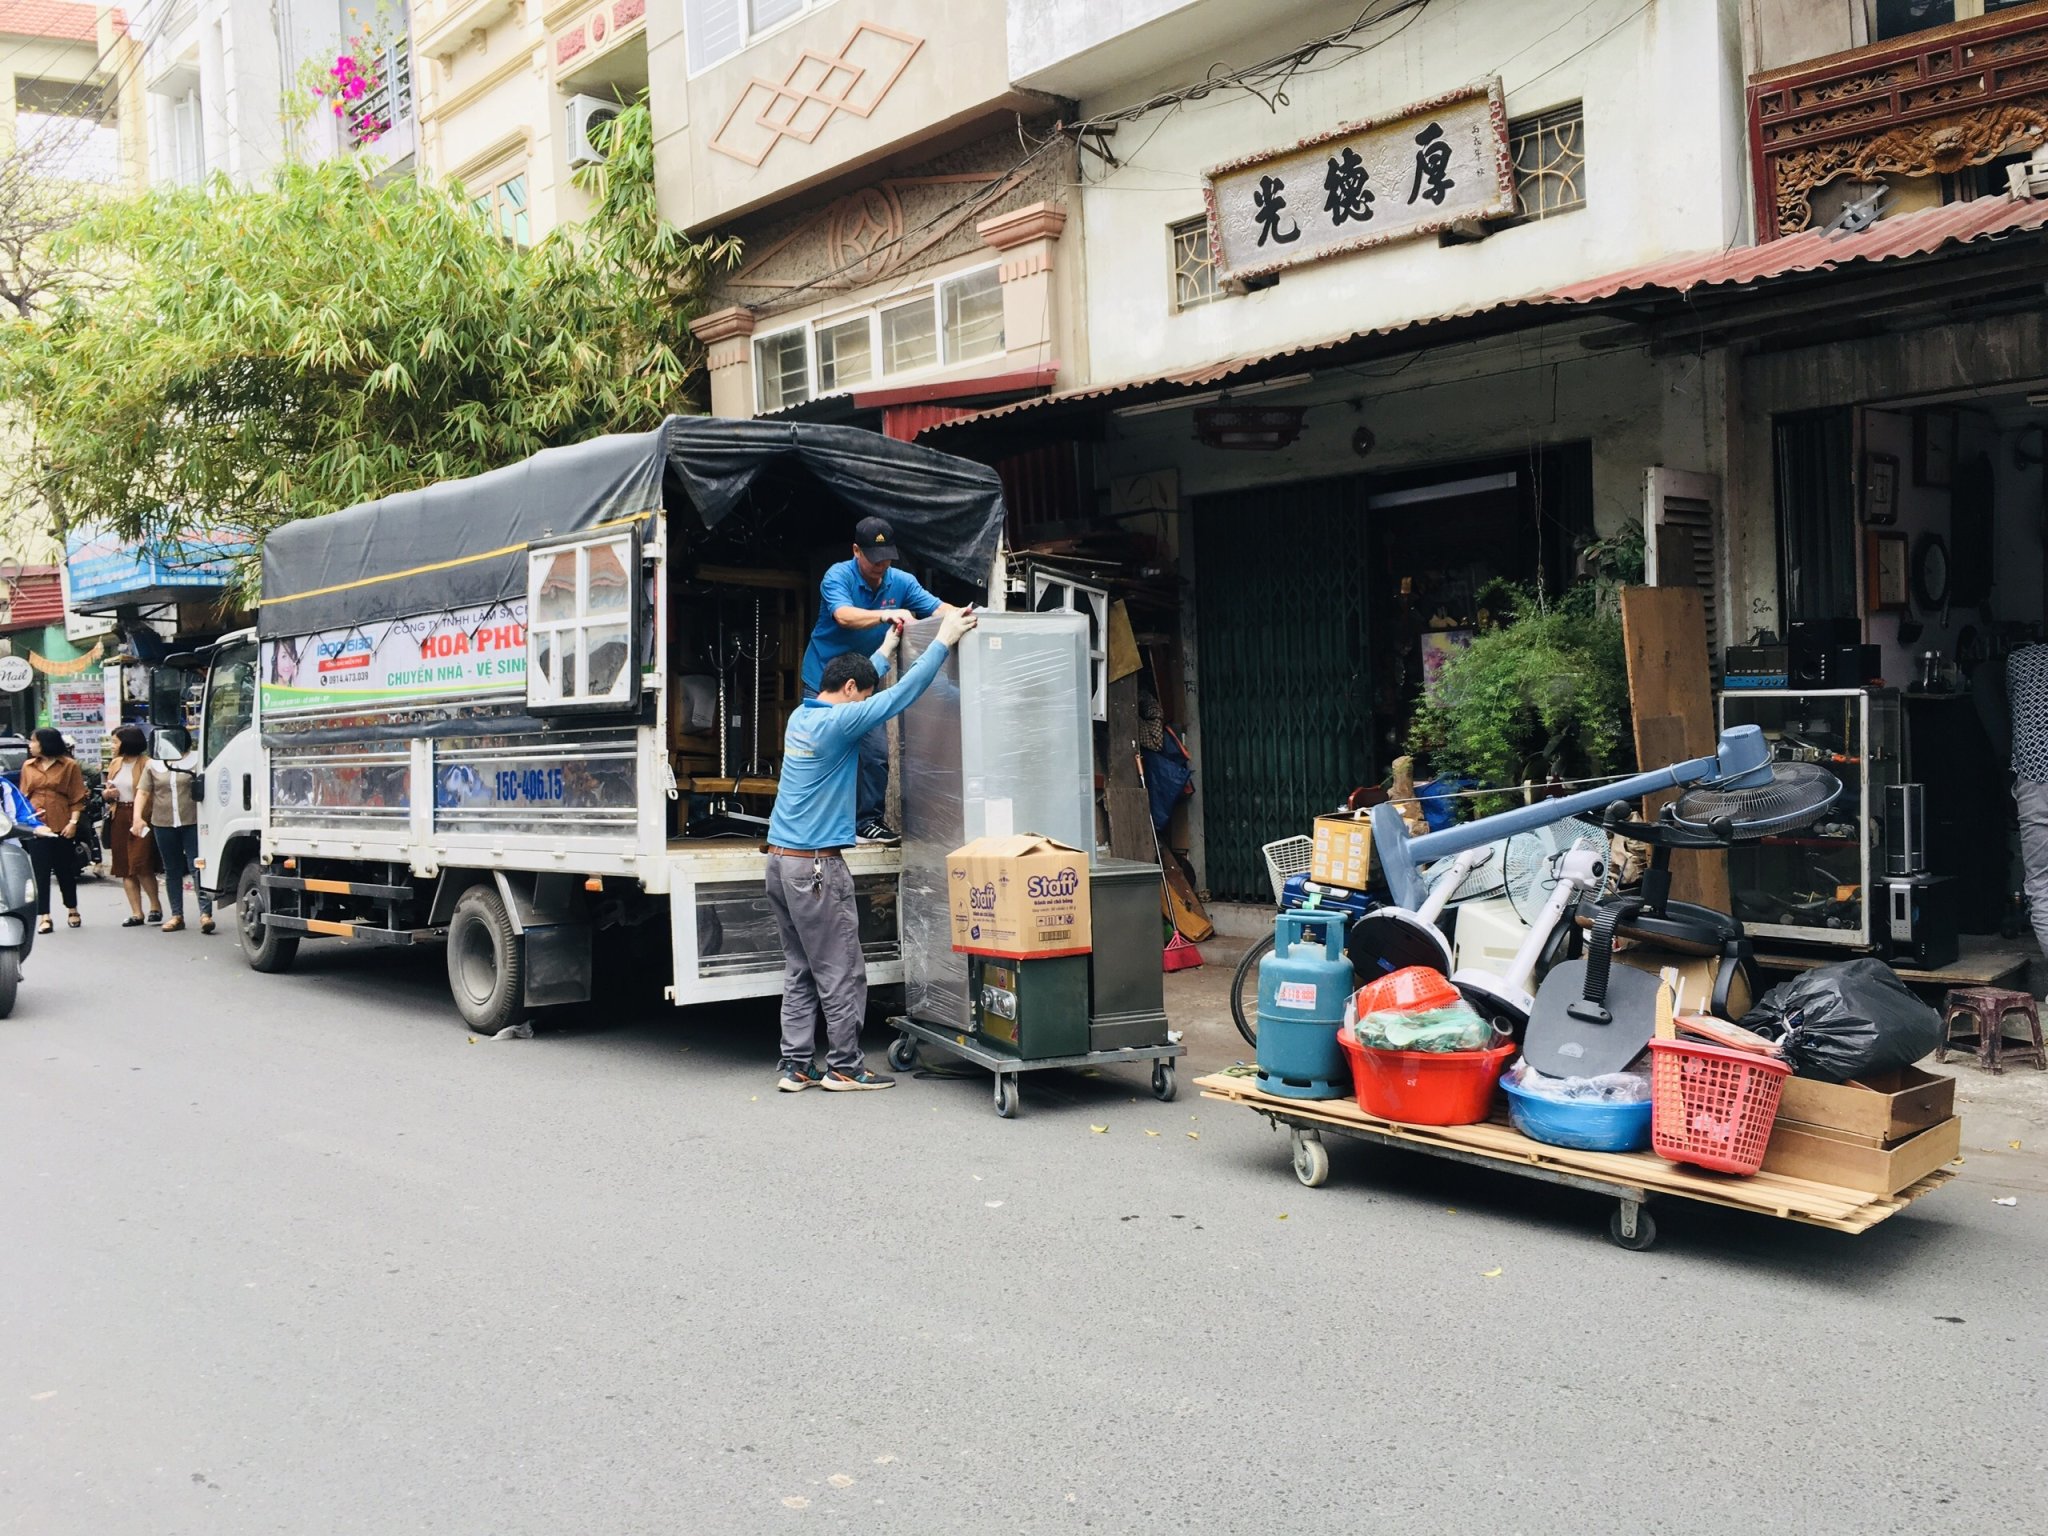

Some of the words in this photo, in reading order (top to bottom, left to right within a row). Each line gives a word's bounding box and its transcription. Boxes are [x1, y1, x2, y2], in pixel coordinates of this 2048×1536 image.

[393, 621, 426, 636] CÔNG
[429, 620, 438, 629] TY
[442, 616, 469, 628] TNHH
[473, 609, 496, 623] LÀM
[421, 632, 469, 660] HOA
[0, 669, 27, 682] Nail
[437, 662, 463, 681] NHÀ
[476, 658, 493, 679] VỆ
[495, 768, 563, 801] 15C-406.15
[970, 882, 996, 909] Staff
[1027, 867, 1078, 898] Staff
